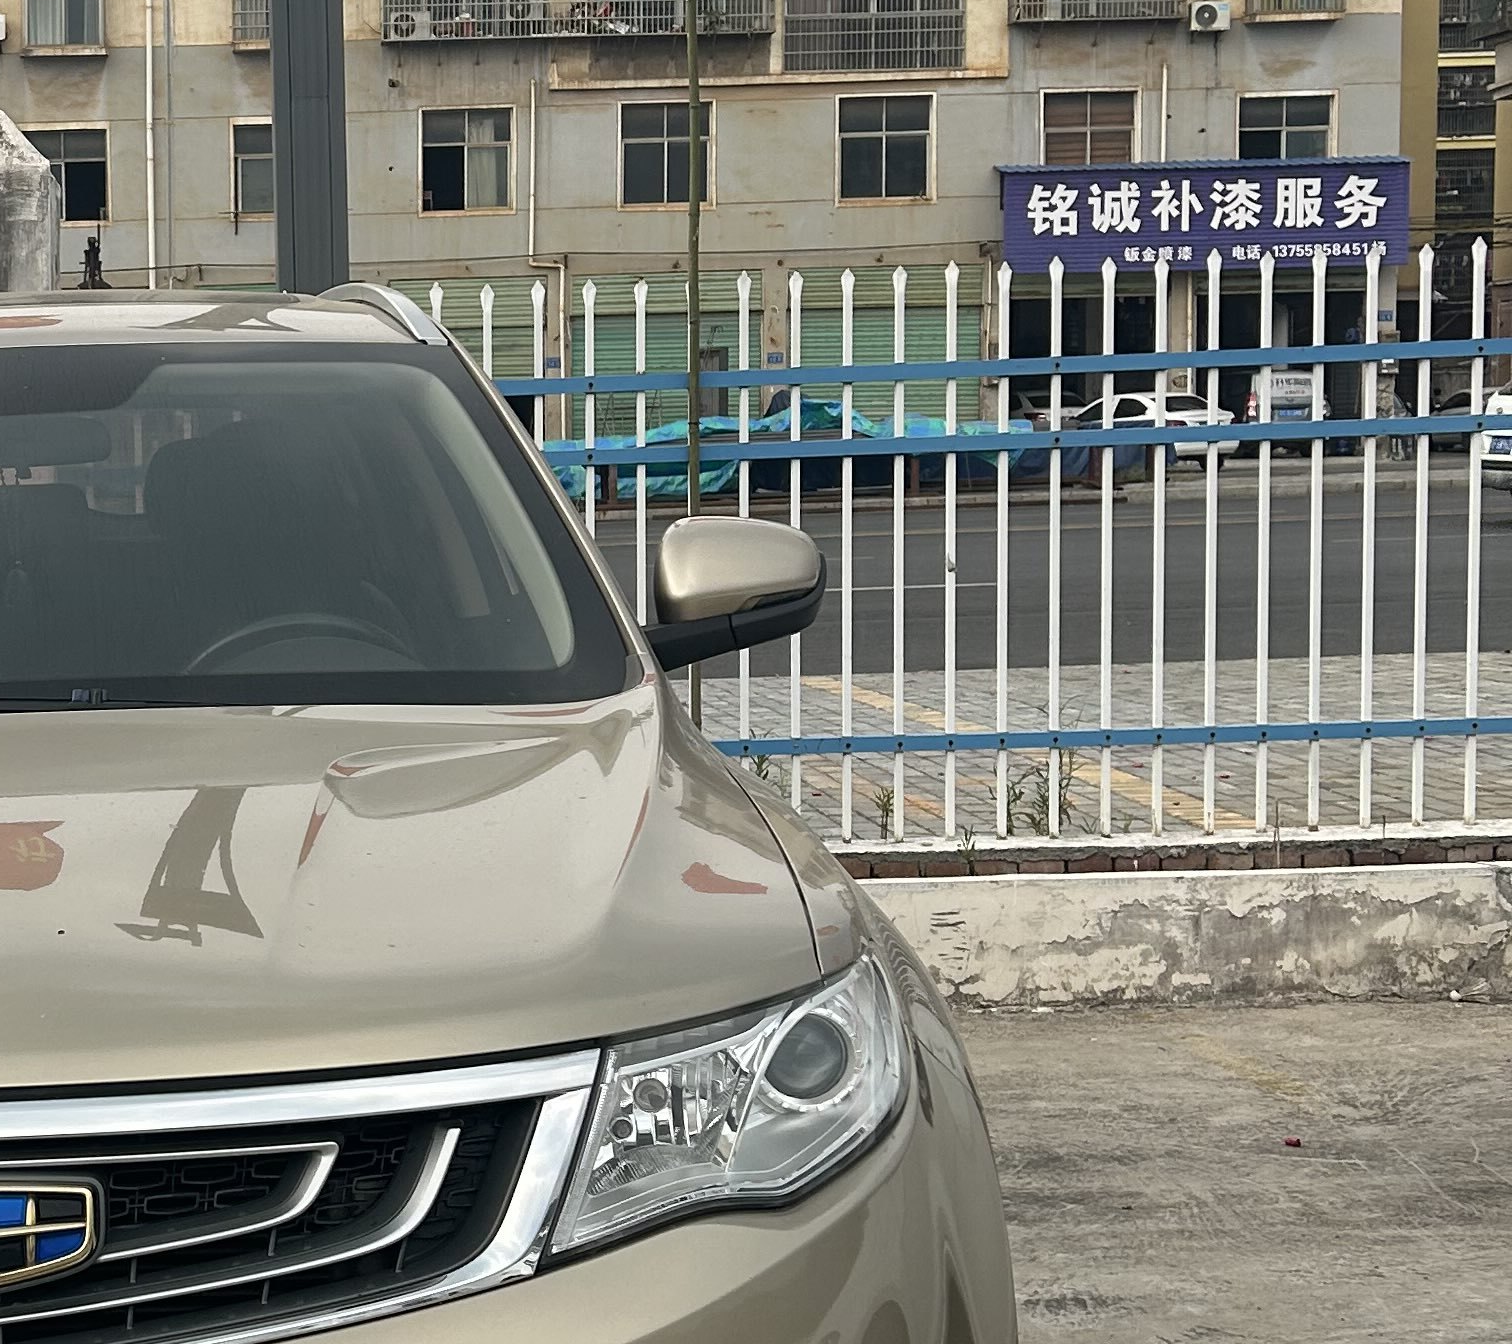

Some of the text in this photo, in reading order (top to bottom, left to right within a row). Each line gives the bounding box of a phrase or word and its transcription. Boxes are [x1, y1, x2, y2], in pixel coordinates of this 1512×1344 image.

[1027, 175, 1387, 236] 铭诚补漆服务
[1232, 244, 1262, 260] 电话
